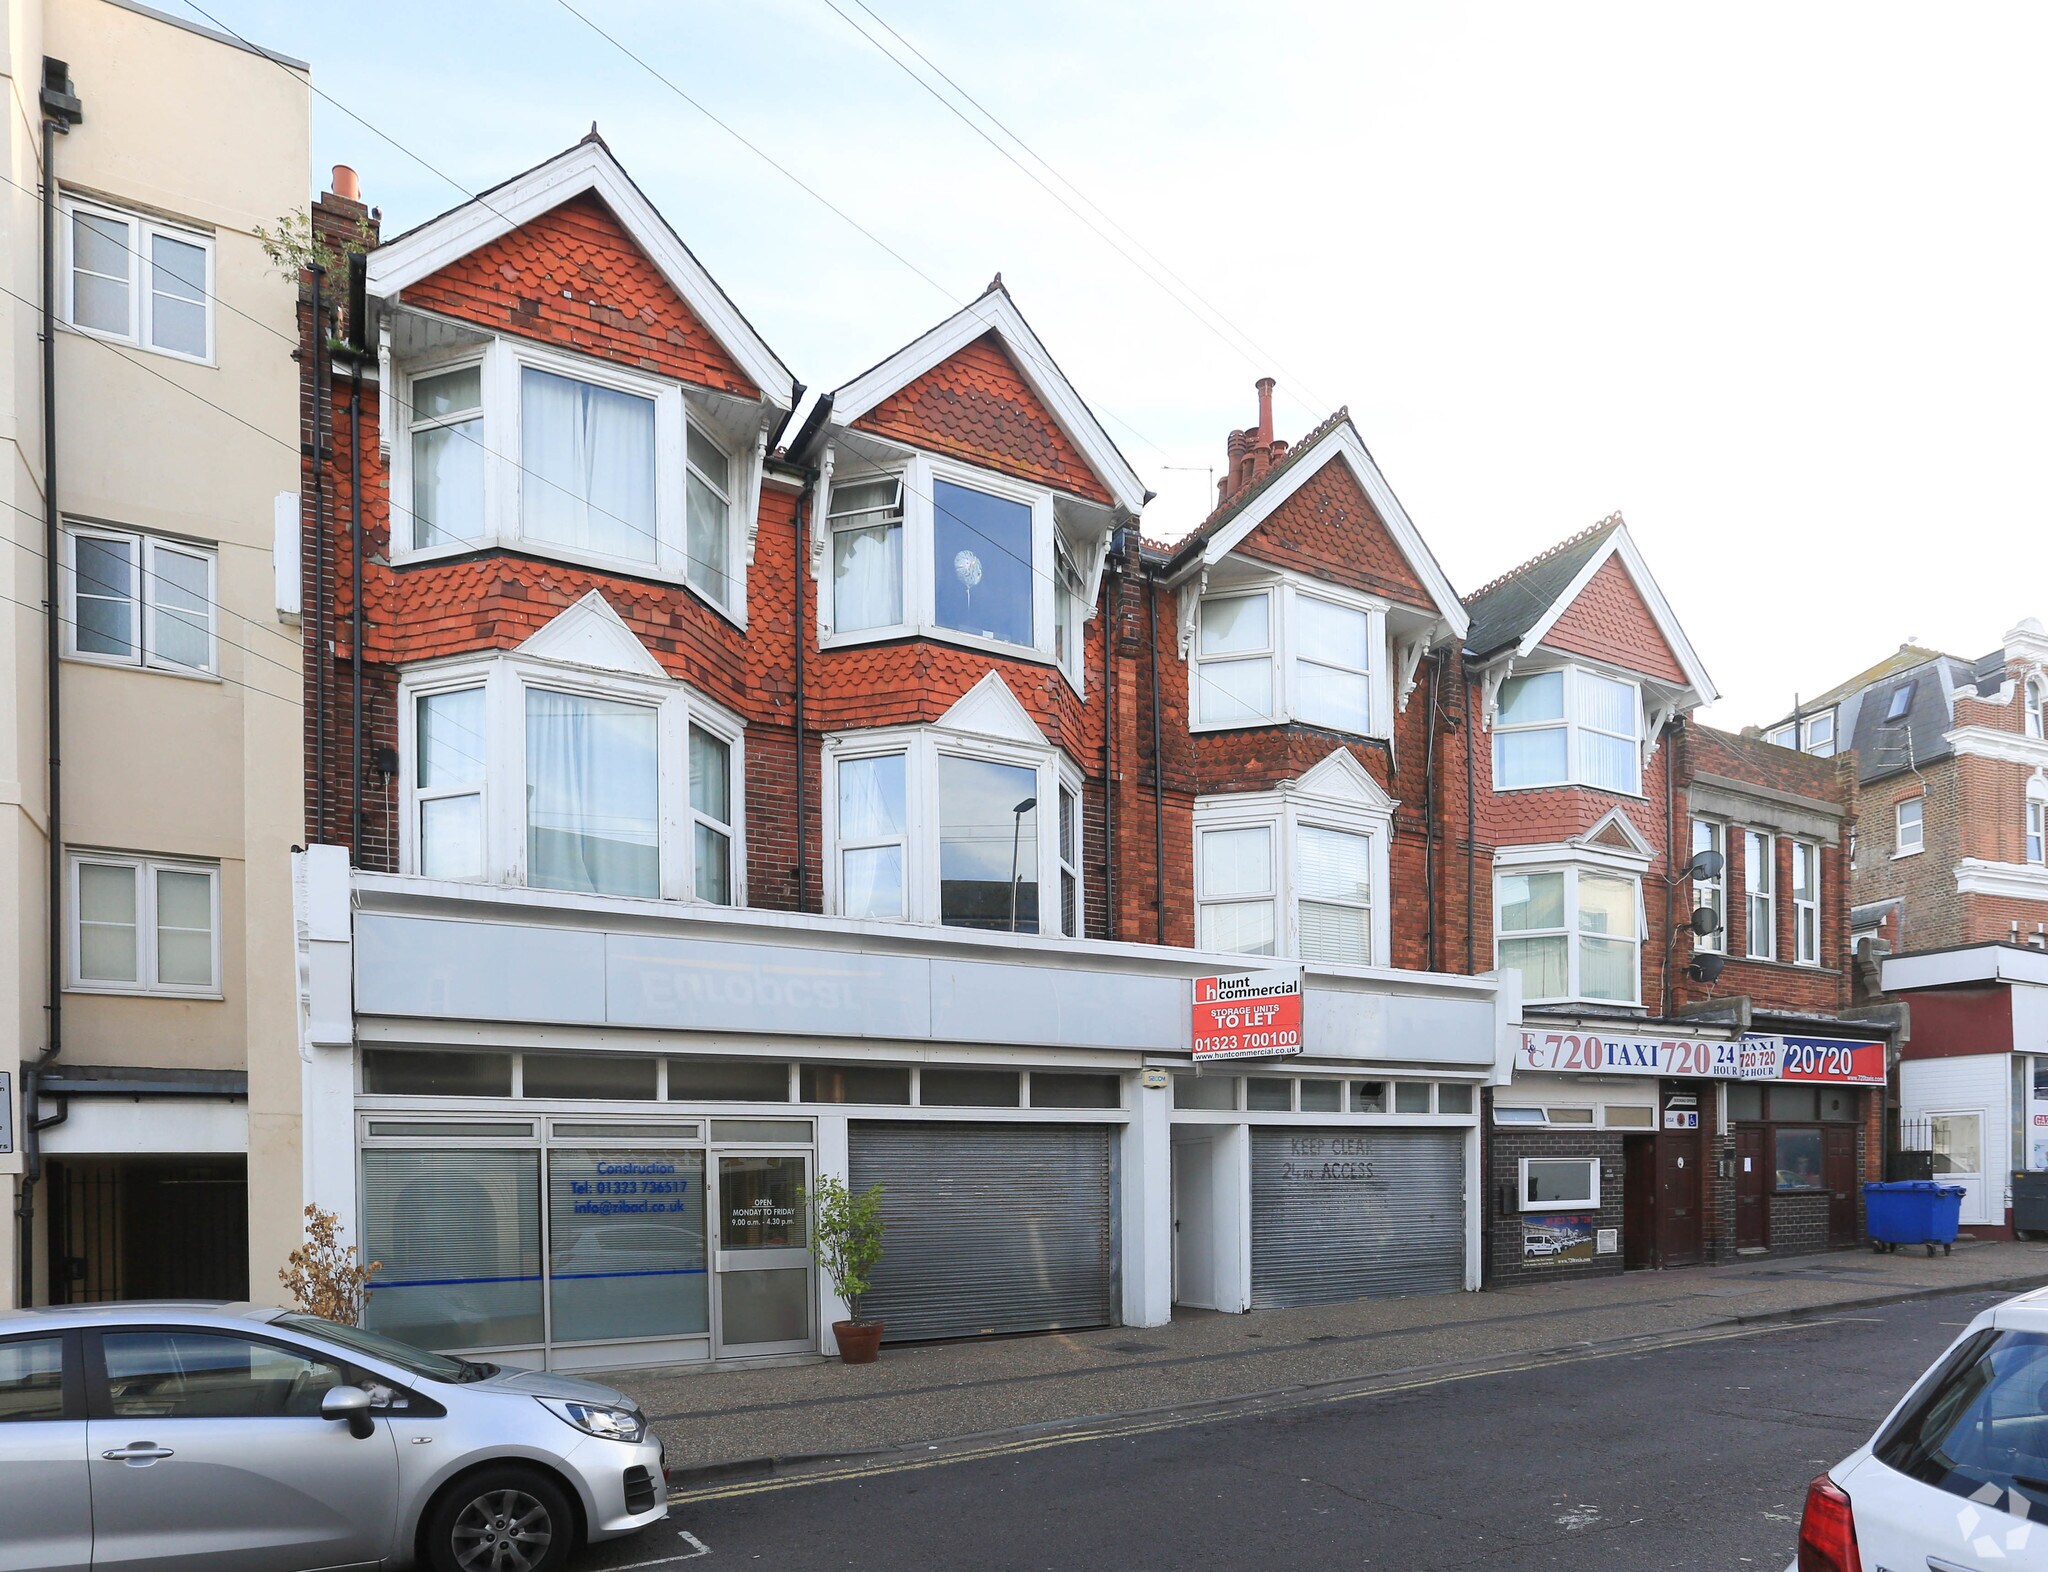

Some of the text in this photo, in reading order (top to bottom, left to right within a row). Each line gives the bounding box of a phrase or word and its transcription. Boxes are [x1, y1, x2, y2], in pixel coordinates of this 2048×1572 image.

[1219, 977, 1250, 989] hunt
[1219, 980, 1297, 1000] commercial
[1210, 1004, 1280, 1017] STORAGE UNITS
[1214, 1011, 1276, 1029] TO LET
[1195, 1030, 1297, 1052] 01323 700100
[1740, 1041, 1774, 1052] TAXI
[1195, 1046, 1297, 1060] www.huntcommercial.co.uk
[1545, 1035, 1603, 1070] 720
[1603, 1043, 1659, 1067] TAXI
[1660, 1041, 1711, 1074] 720
[1717, 1045, 1735, 1064] 24
[1713, 1065, 1738, 1075] HOUR
[1741, 1066, 1774, 1078] 24 HOUR
[1290, 1137, 1325, 1156] KEEP
[597, 1161, 675, 1174] Construction
[1321, 1162, 1374, 1179] ACCESS
[571, 1180, 688, 1194] Tel: 01323 736517
[781, 1219, 795, 1227] p.m.
